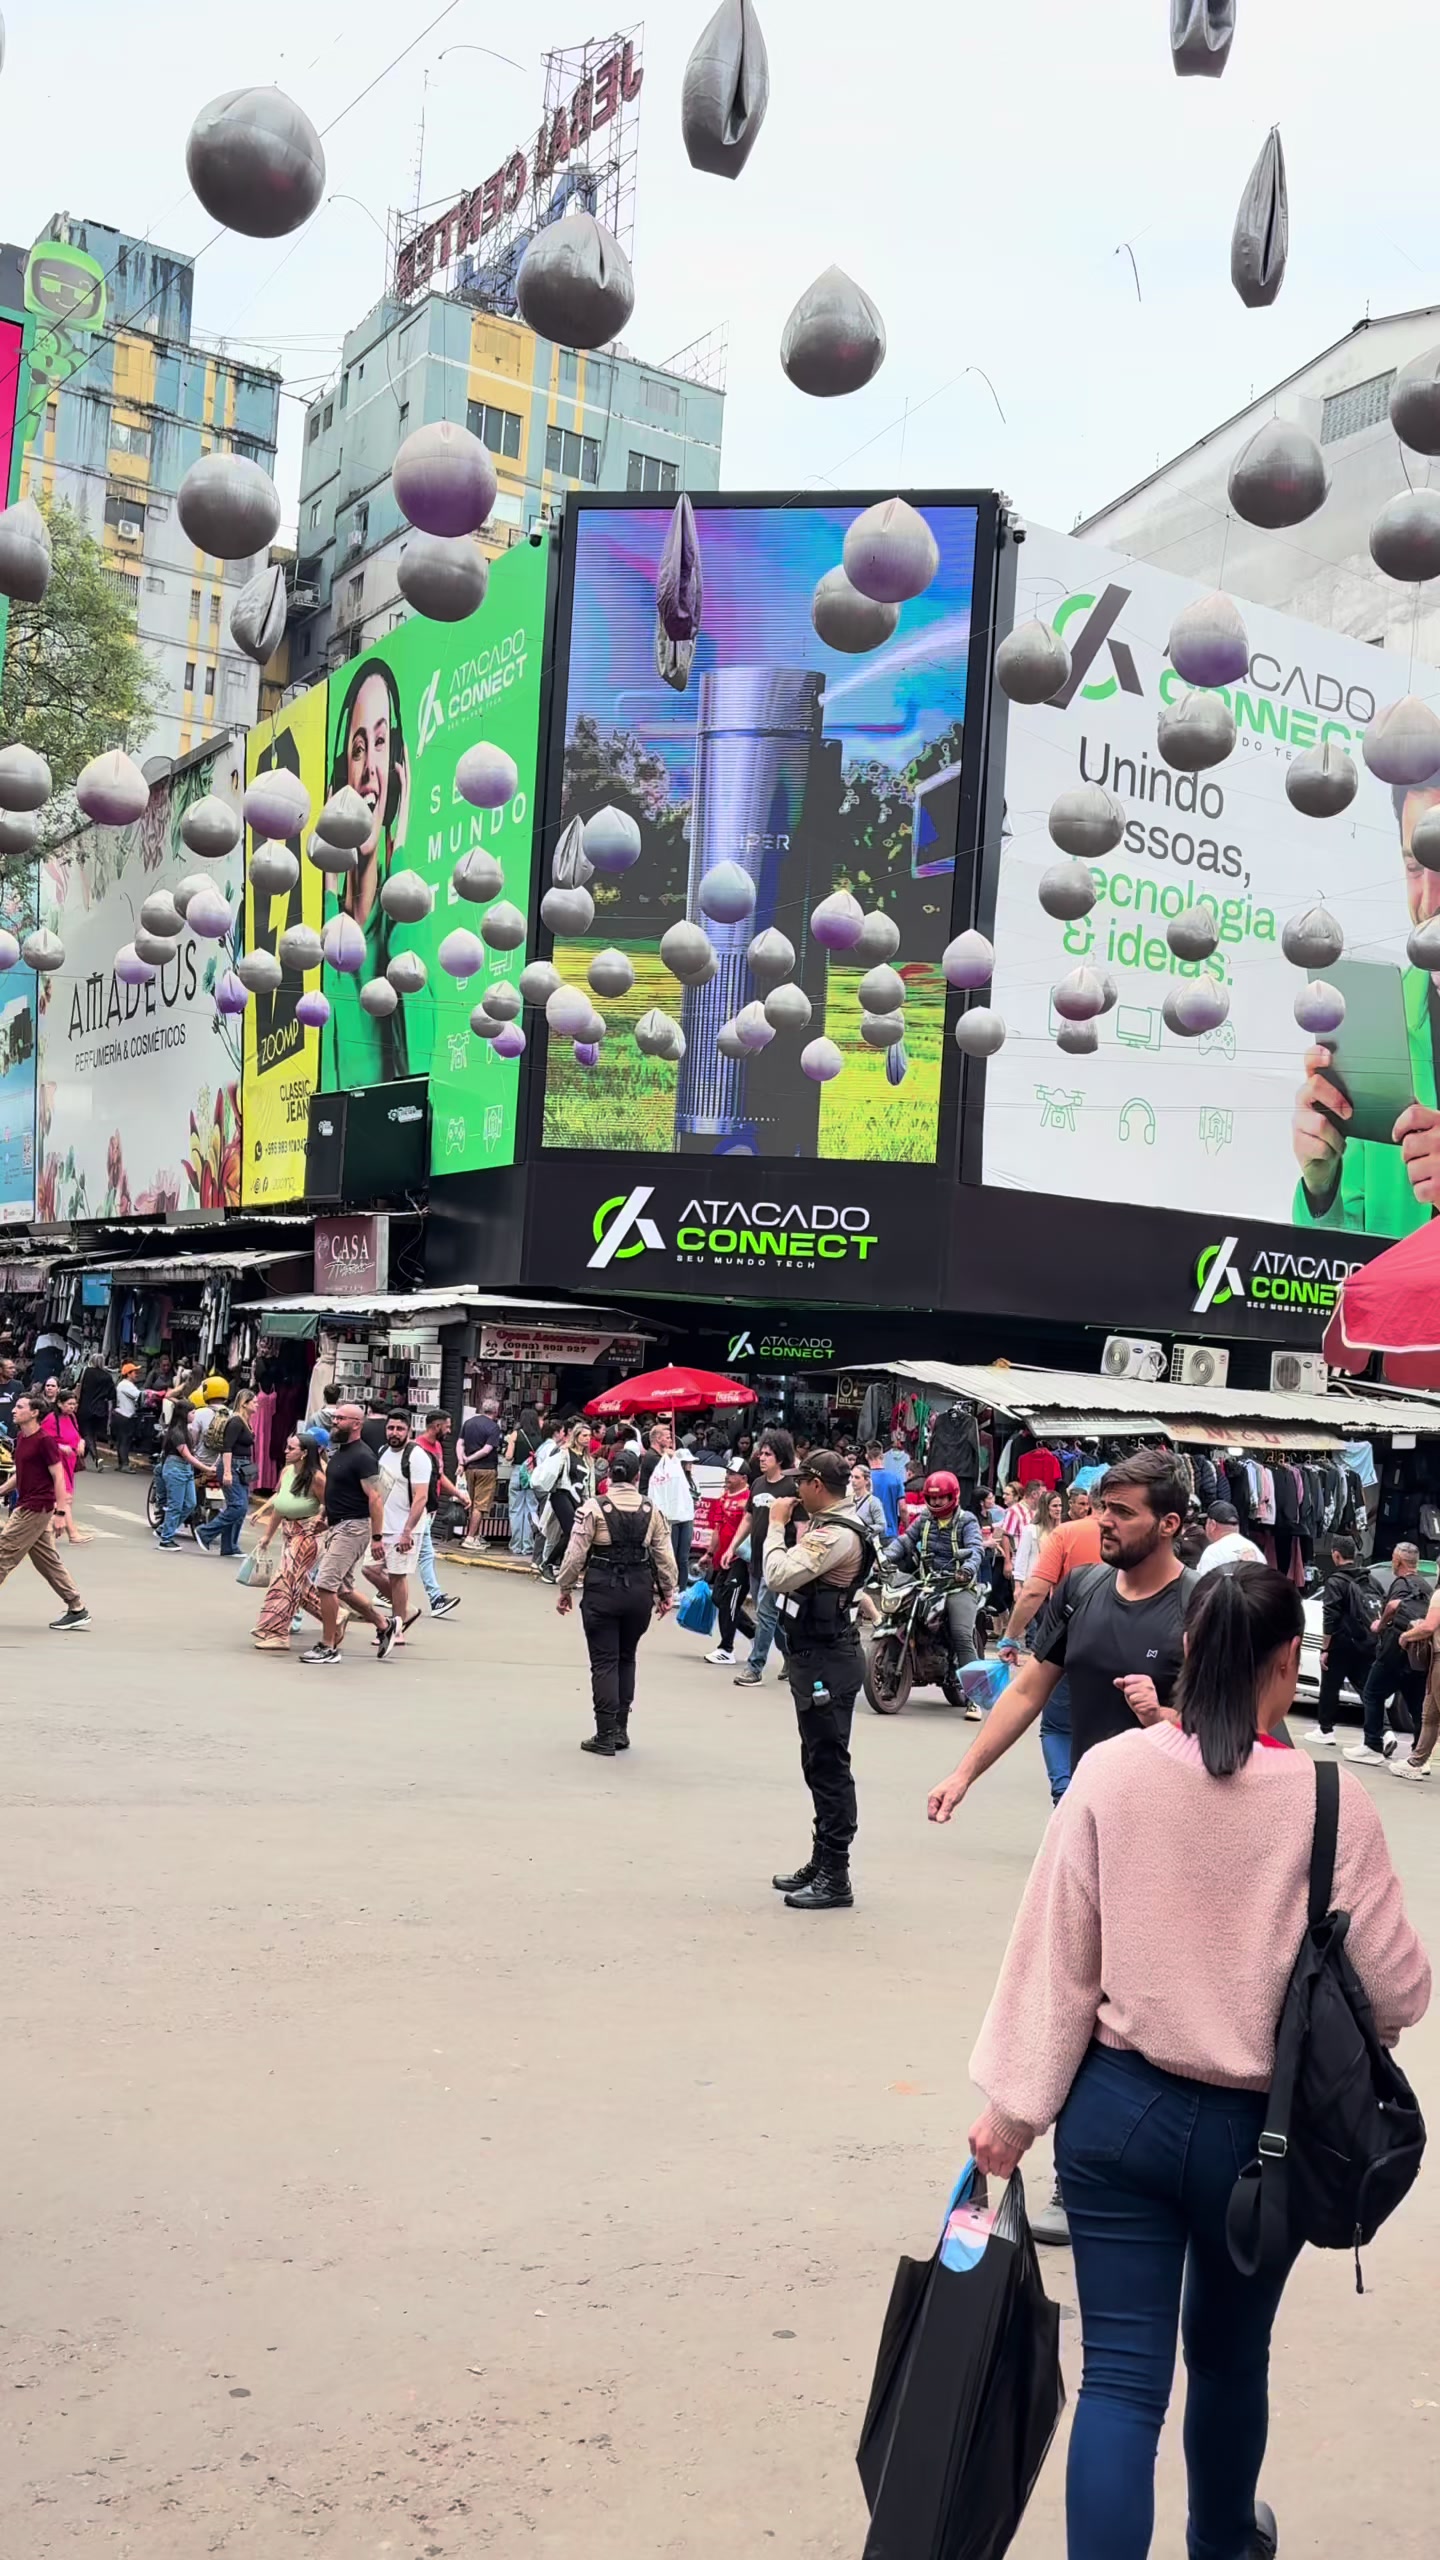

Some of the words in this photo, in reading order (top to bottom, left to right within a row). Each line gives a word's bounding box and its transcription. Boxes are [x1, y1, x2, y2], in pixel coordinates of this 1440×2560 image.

[450, 629, 525, 693] ATACADO
[448, 653, 527, 718] CONNECT
[1079, 736, 1224, 819] Unindo
[428, 792, 526, 863] MUNDO
[1123, 820, 1251, 889] ssoas,
[123, 1040, 129, 1060] &
[131, 1024, 186, 1058] COSMÉTICOS
[260, 1018, 299, 1065] ZOOMP
[678, 1199, 871, 1231] ATACADO
[331, 1234, 369, 1260] CASA
[676, 1227, 878, 1260] CONNECT
[676, 1255, 704, 1263] SEU
[714, 1256, 766, 1267] MUNDO
[776, 1259, 815, 1269] TECH
[1251, 1276, 1335, 1306] CONNE
[1308, 1307, 1332, 1316] TECH
[760, 1336, 832, 1348] ATACADO
[760, 1346, 835, 1359] CONNECT
